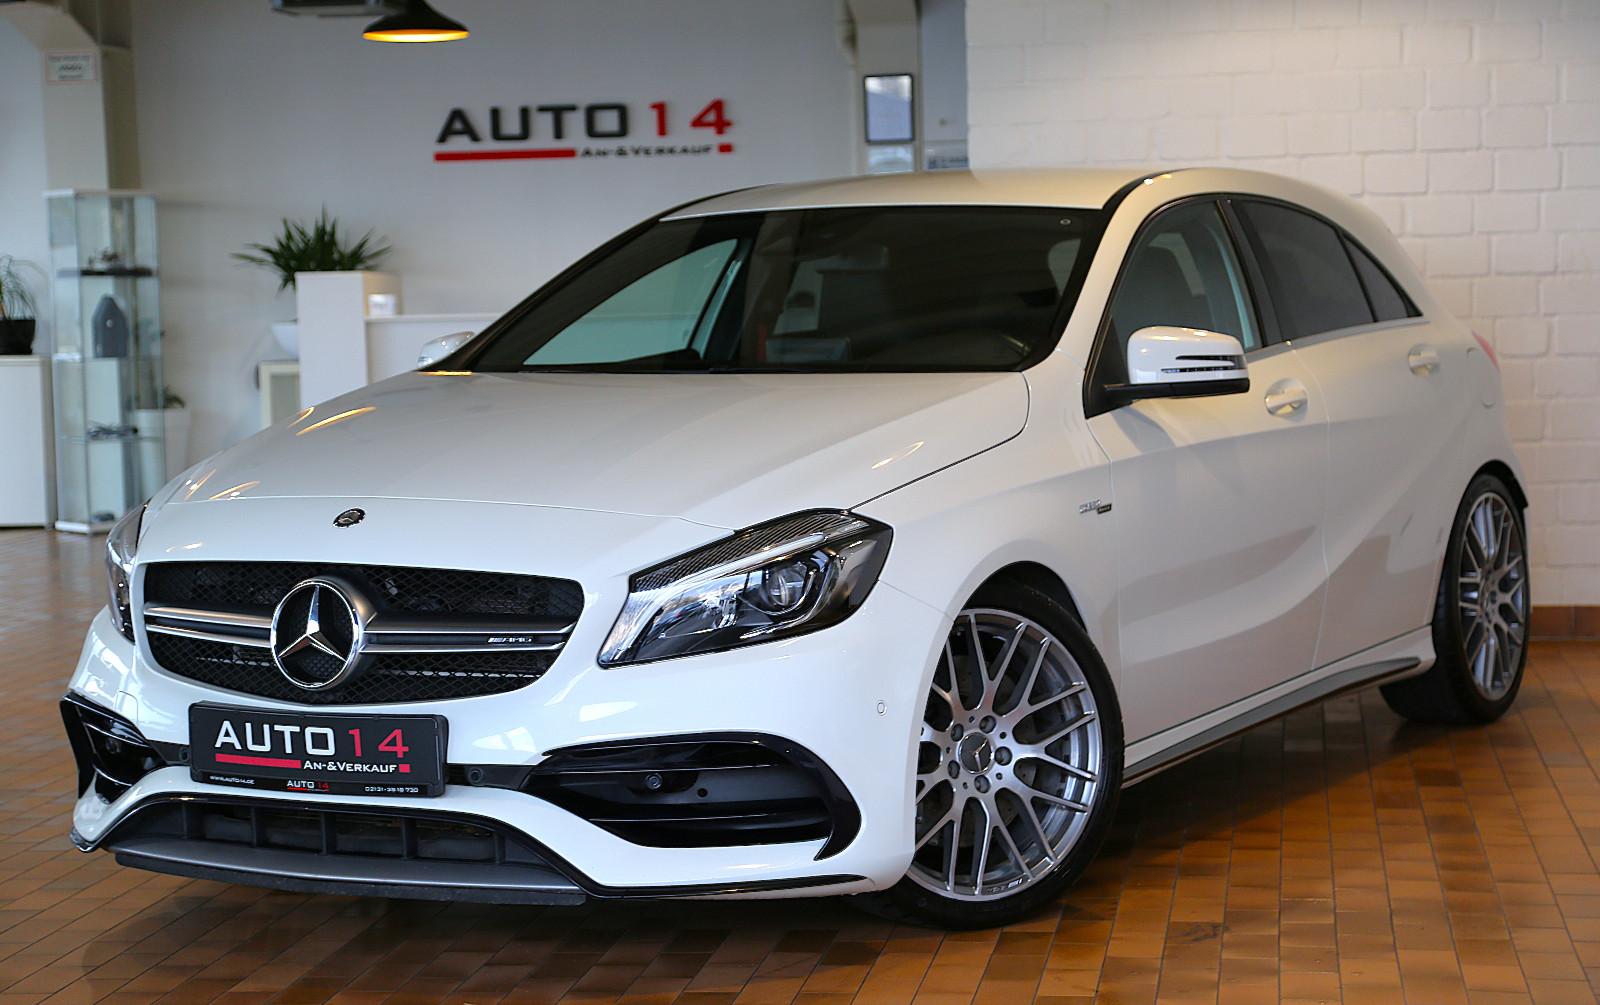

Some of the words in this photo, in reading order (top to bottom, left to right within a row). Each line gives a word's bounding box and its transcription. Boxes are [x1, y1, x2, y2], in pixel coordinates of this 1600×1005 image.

[436, 103, 629, 143] AUTO
[649, 99, 733, 137] 14
[214, 720, 336, 756] AUTO
[347, 728, 410, 759] 14
[286, 779, 315, 789] AUTO
